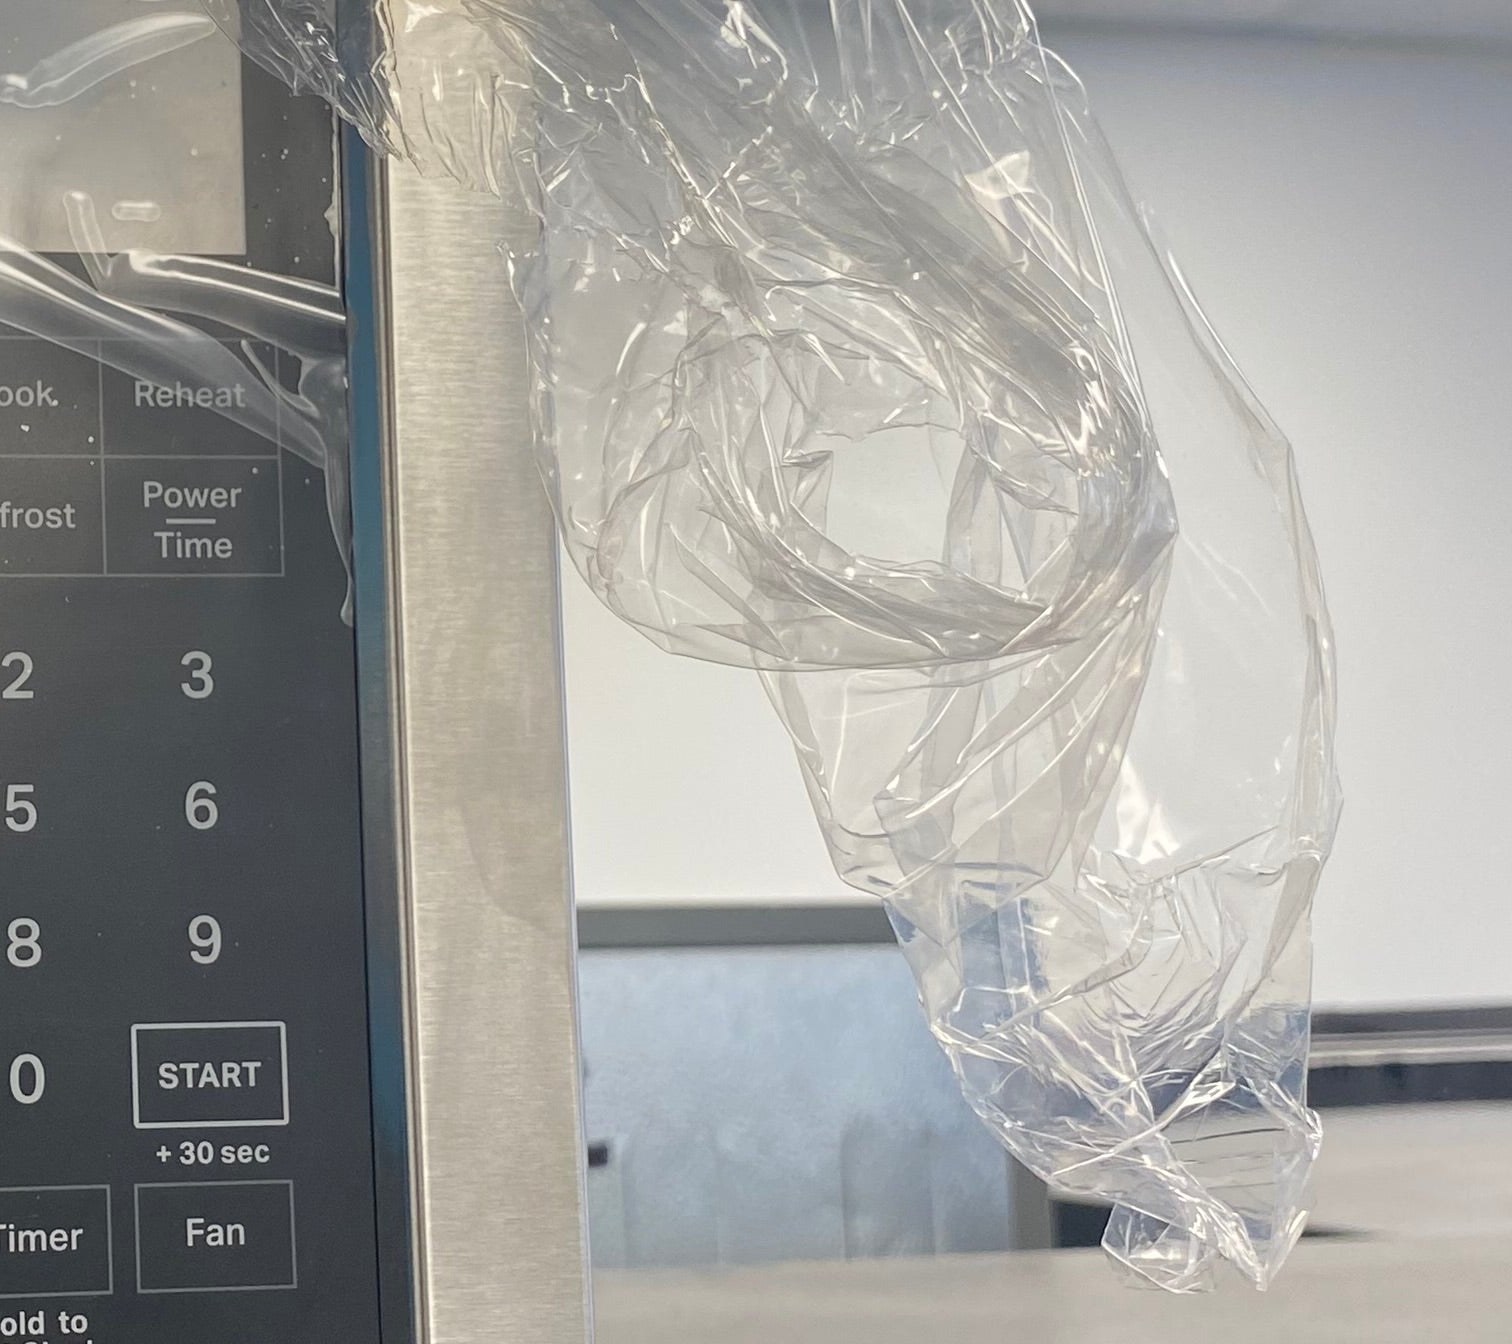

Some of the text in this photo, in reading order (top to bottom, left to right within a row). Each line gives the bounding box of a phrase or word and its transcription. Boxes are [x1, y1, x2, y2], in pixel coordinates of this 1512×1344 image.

[134, 380, 246, 409] Reheat
[142, 481, 242, 510] Power
[154, 532, 233, 560] Time
[1, 651, 34, 700] 2
[180, 651, 214, 700] 3
[5, 785, 37, 832] 5
[184, 781, 219, 830] 6
[6, 918, 42, 967] 8
[188, 915, 222, 964] 9
[9, 1054, 45, 1104] 0
[158, 1063, 261, 1089] START
[156, 1142, 270, 1165] + 30 sec
[186, 1218, 246, 1247] Fan
[58, 1312, 88, 1336] to
